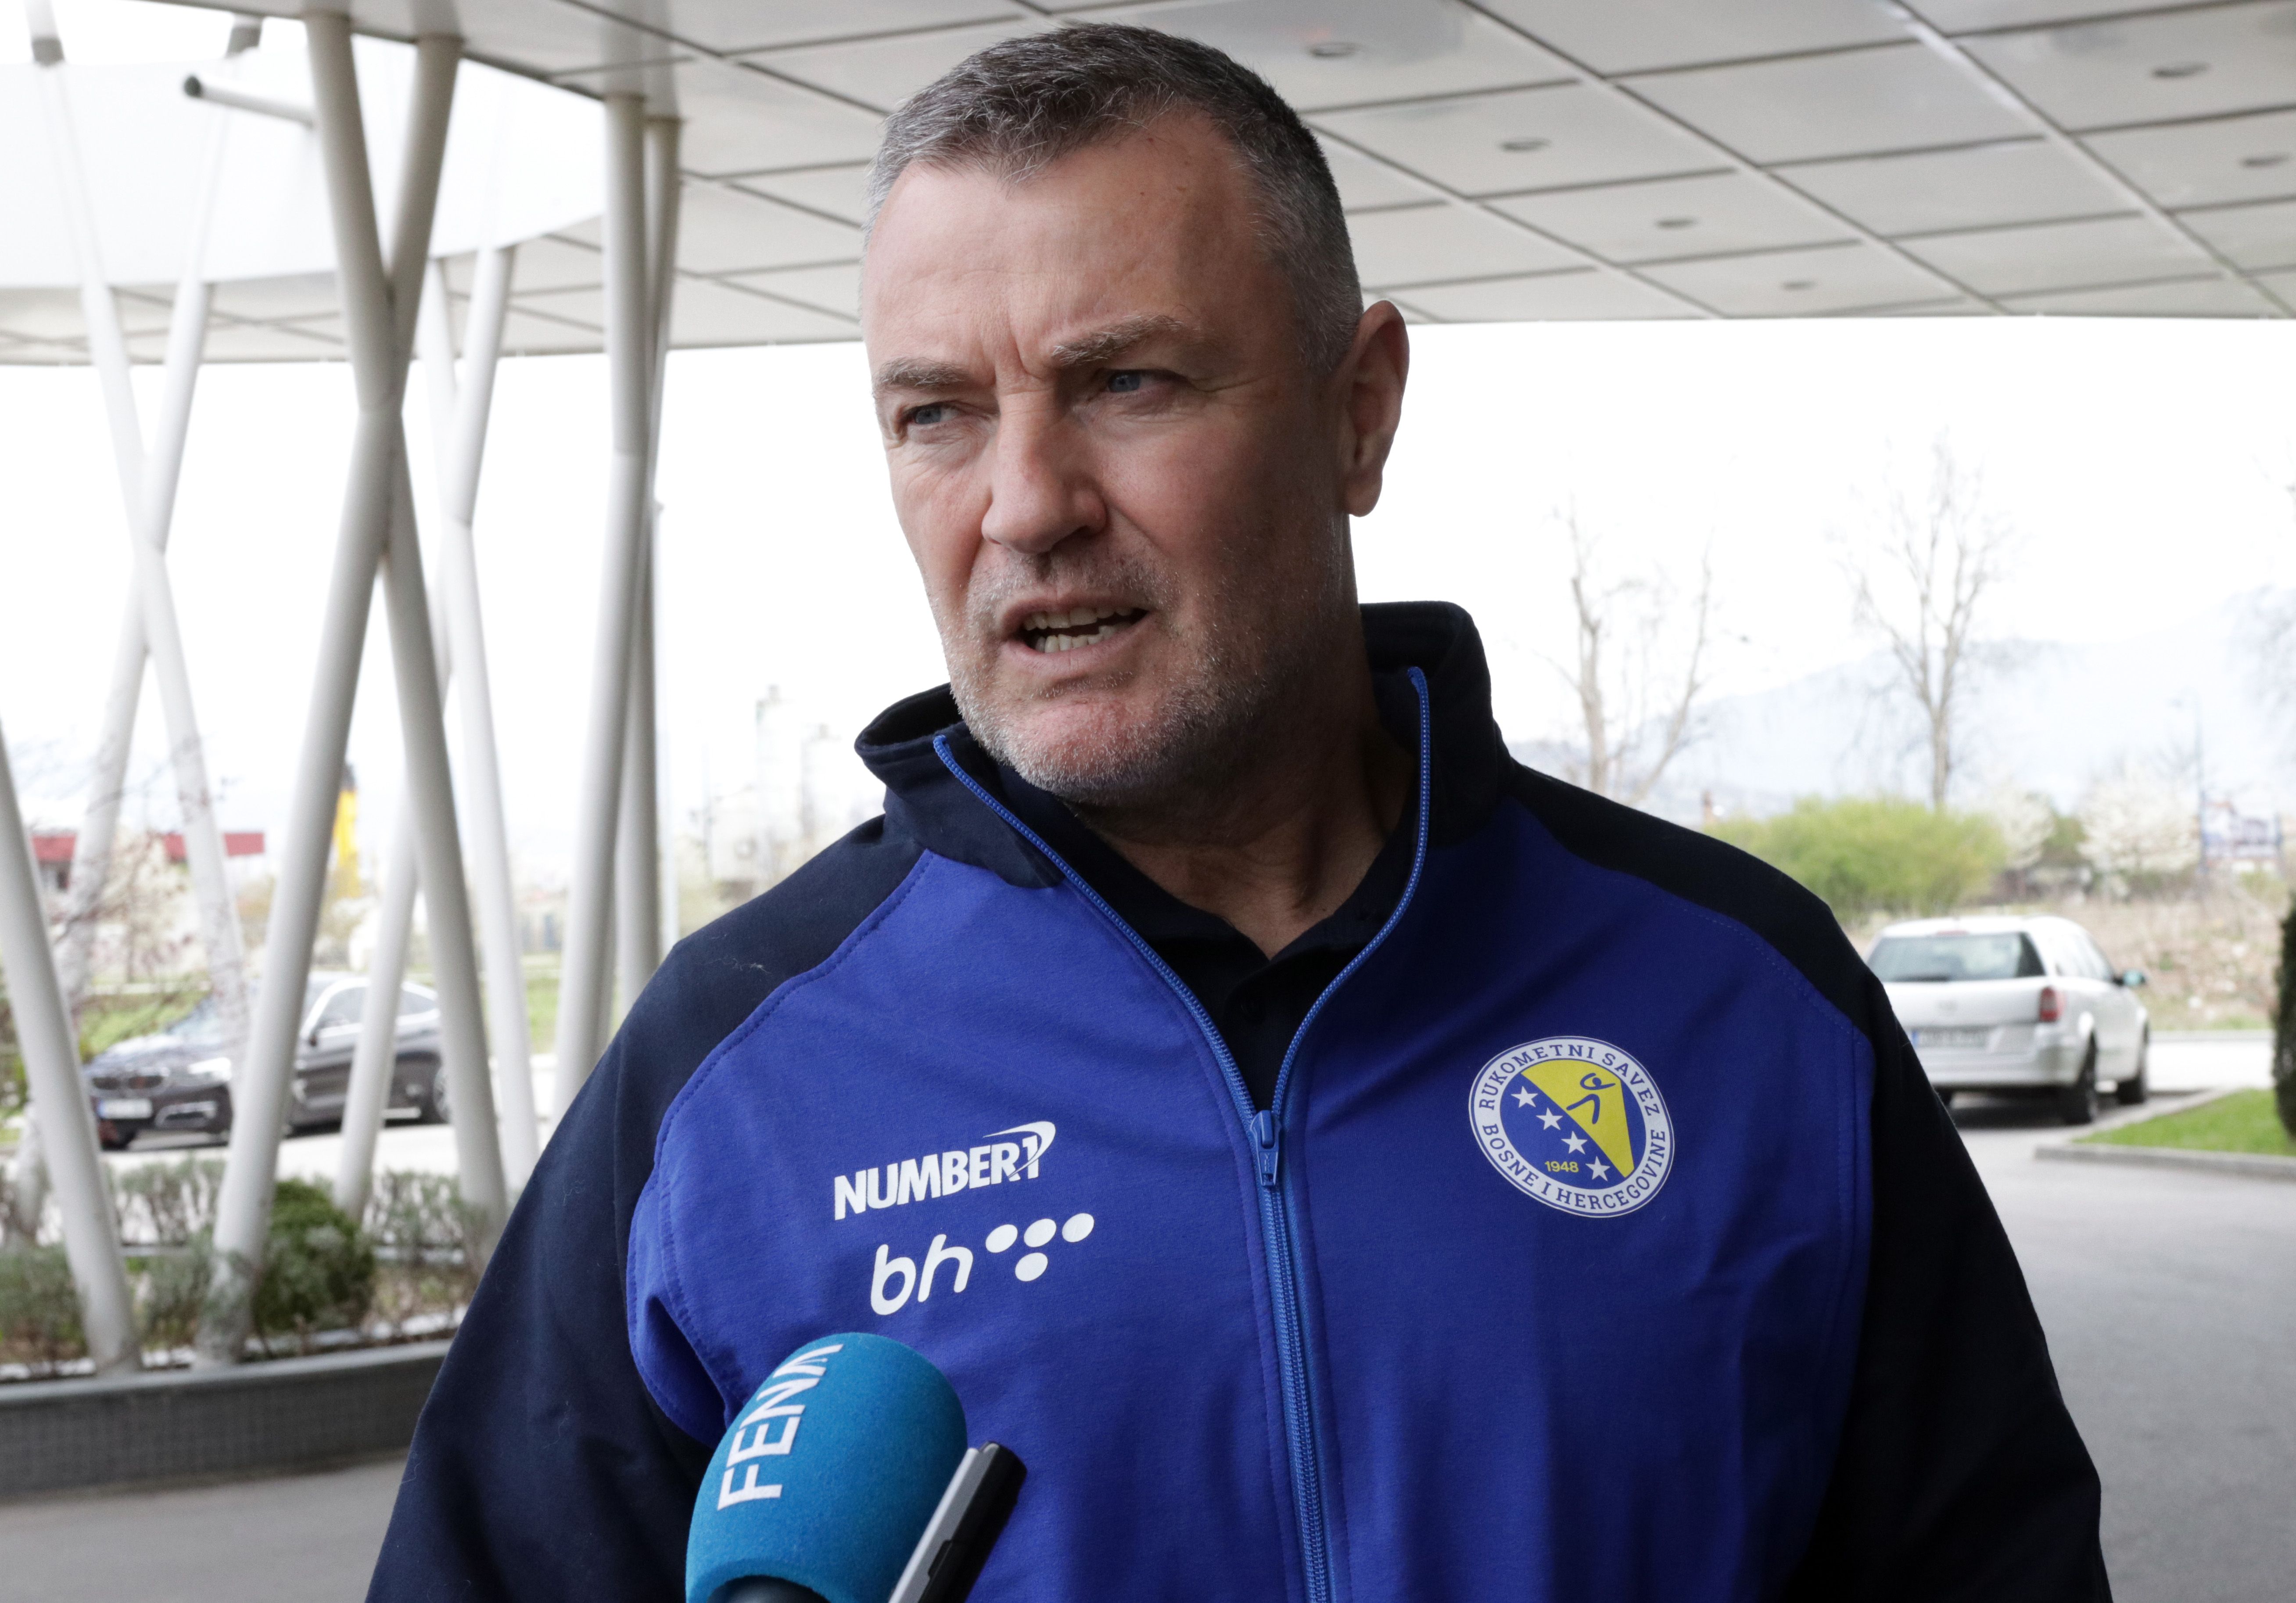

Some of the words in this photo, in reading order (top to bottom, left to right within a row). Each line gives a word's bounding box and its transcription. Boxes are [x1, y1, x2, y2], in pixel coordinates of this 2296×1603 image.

[1478, 1044, 1595, 1111] RUKOMETNI
[1602, 1053, 1660, 1117] SAVEZ
[1482, 1123, 1539, 1187] BOSNE
[1541, 1181, 1550, 1196] I
[1555, 1129, 1665, 1210] HERCEGOVINE
[1544, 1161, 1579, 1173] 1948
[871, 1233, 974, 1315] bh
[717, 1343, 844, 1511] FENA
